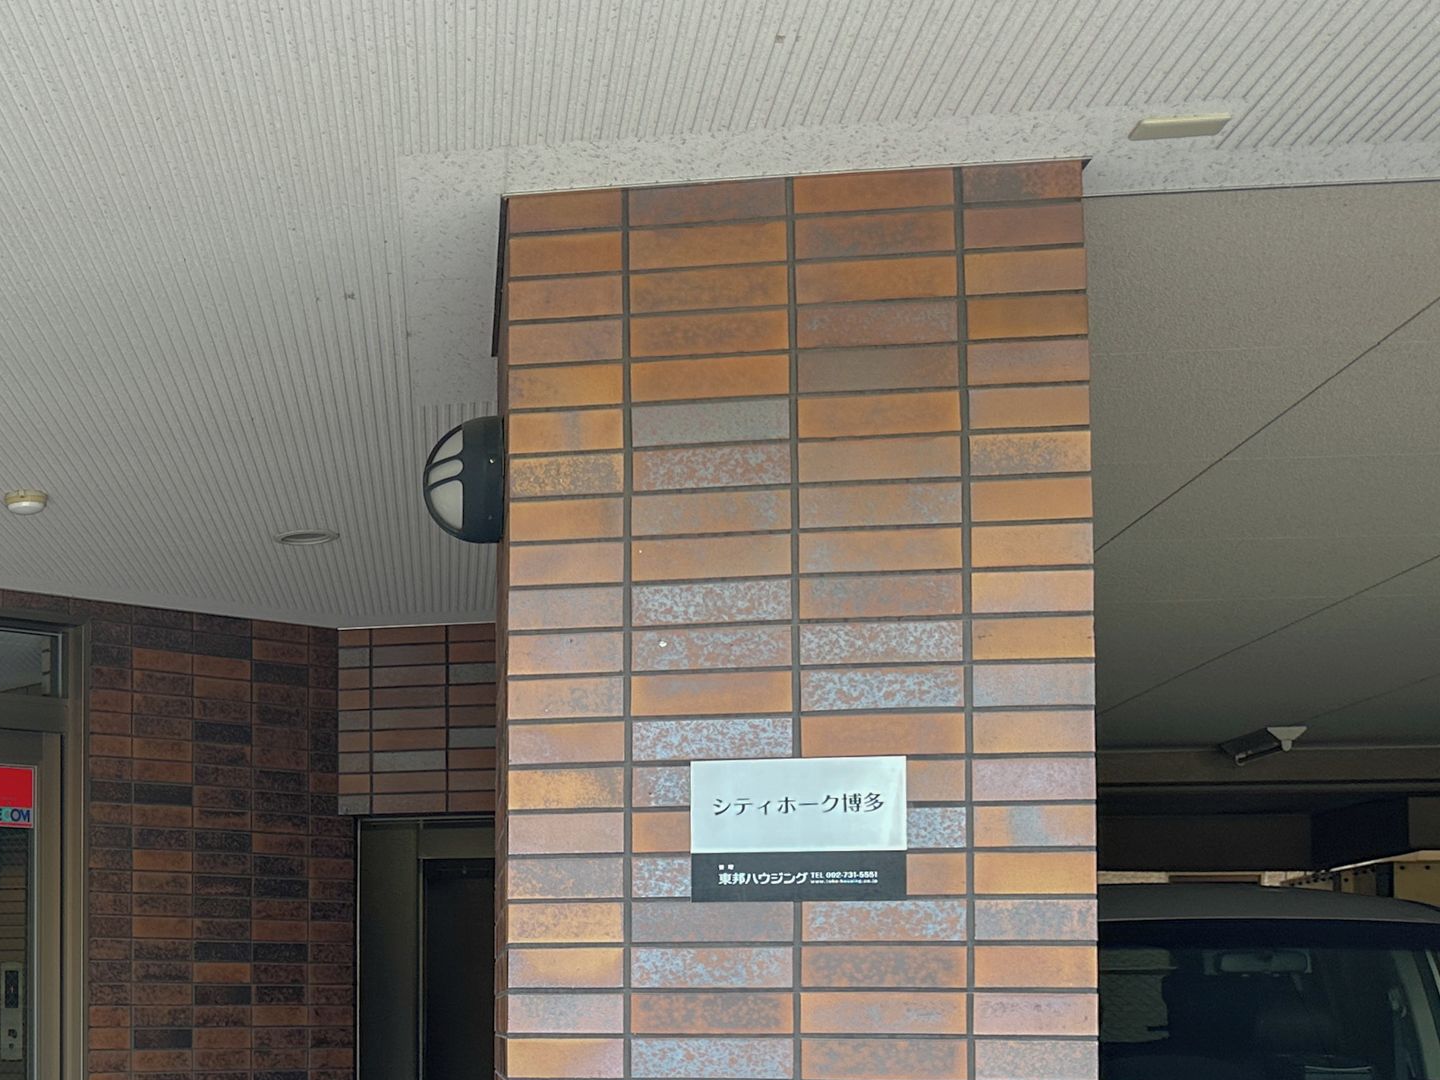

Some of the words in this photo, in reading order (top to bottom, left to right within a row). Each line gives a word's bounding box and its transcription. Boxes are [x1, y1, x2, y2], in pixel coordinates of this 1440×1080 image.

[712, 792, 885, 817] シティホーク博多
[718, 872, 809, 885] 東邦ハウジング
[810, 871, 824, 879] TEL
